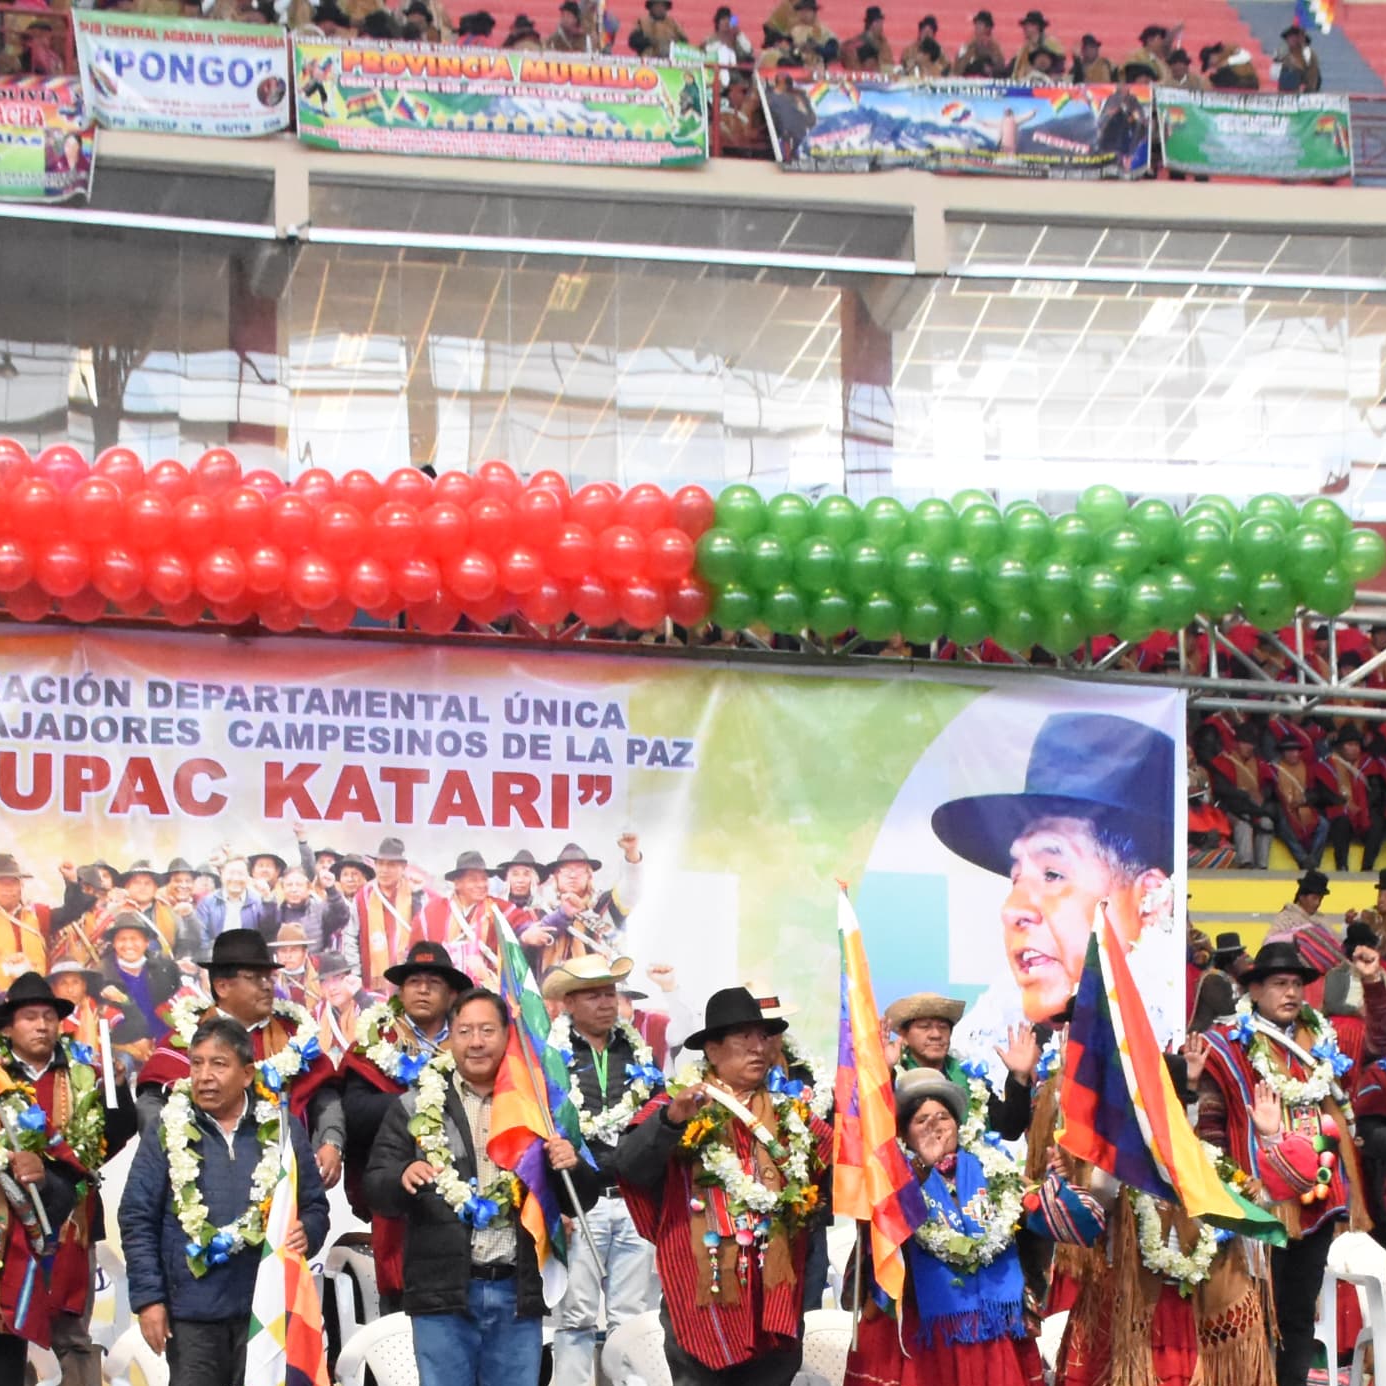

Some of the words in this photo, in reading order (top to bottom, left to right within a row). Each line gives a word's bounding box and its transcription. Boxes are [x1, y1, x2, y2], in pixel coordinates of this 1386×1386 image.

[105, 24, 159, 41] CENTRAL
[163, 29, 214, 43] AGRARIA
[217, 33, 286, 48] ORIGINARIA
[341, 49, 513, 82] PROVINCIA
[520, 58, 659, 90] MURILLO
[147, 680, 490, 724] DEPARTAMENTAL
[504, 690, 626, 730] ÚNICA
[228, 719, 488, 759] CAMPESINOS
[503, 732, 552, 761] DE
[566, 735, 613, 764] LA
[627, 738, 695, 768] PAZ
[263, 761, 613, 830] KATARI”
